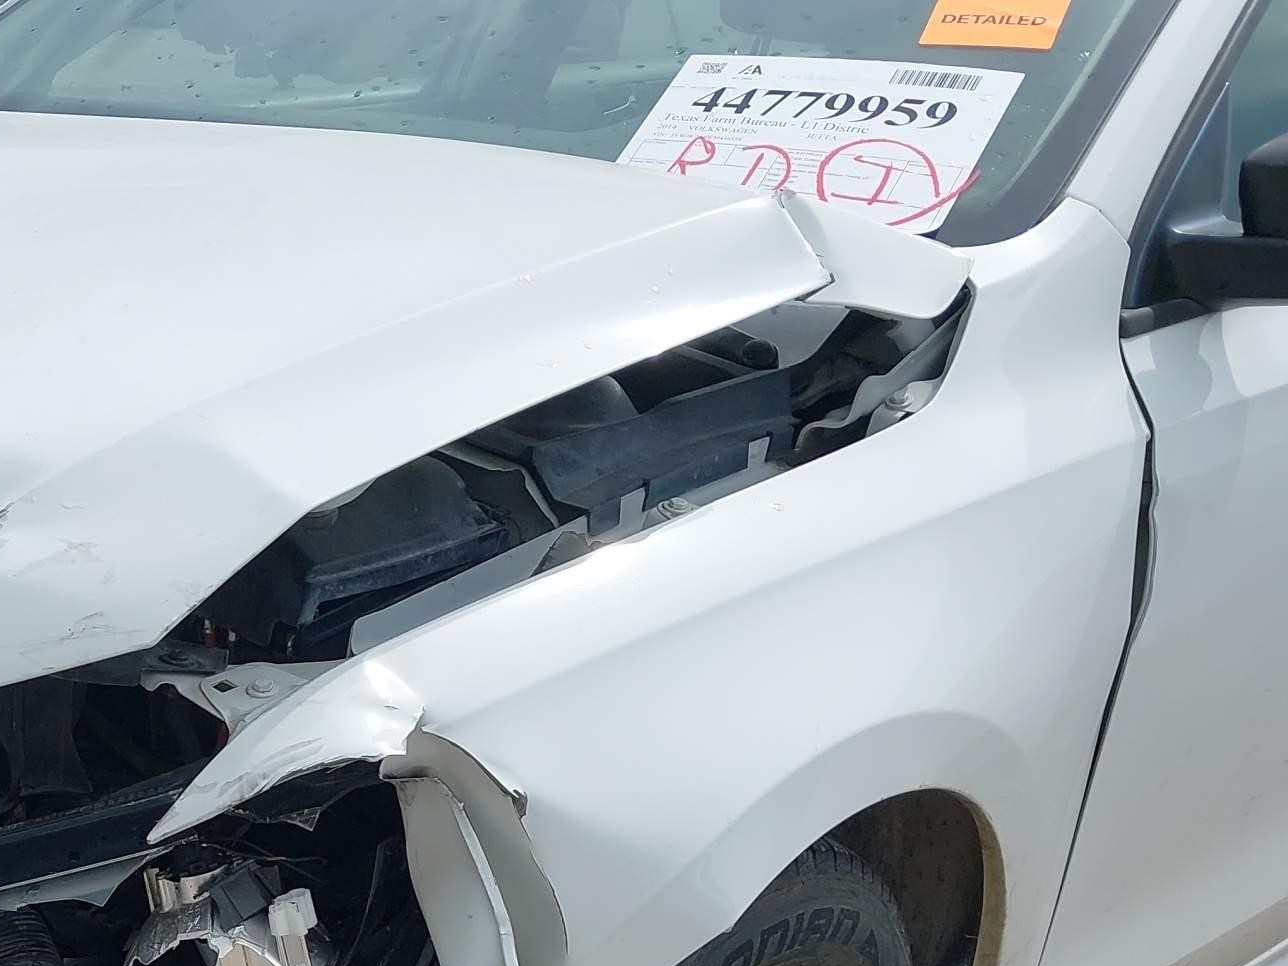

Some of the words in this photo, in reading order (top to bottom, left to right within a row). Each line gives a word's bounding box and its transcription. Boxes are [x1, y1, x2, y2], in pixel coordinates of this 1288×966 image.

[941, 14, 1047, 26] DETAILED
[691, 87, 958, 129] 44779959
[664, 113, 698, 122] Texas
[703, 113, 736, 124] Farm
[740, 117, 787, 128] Bureau
[689, 125, 760, 135] VOLKSWAGEN
